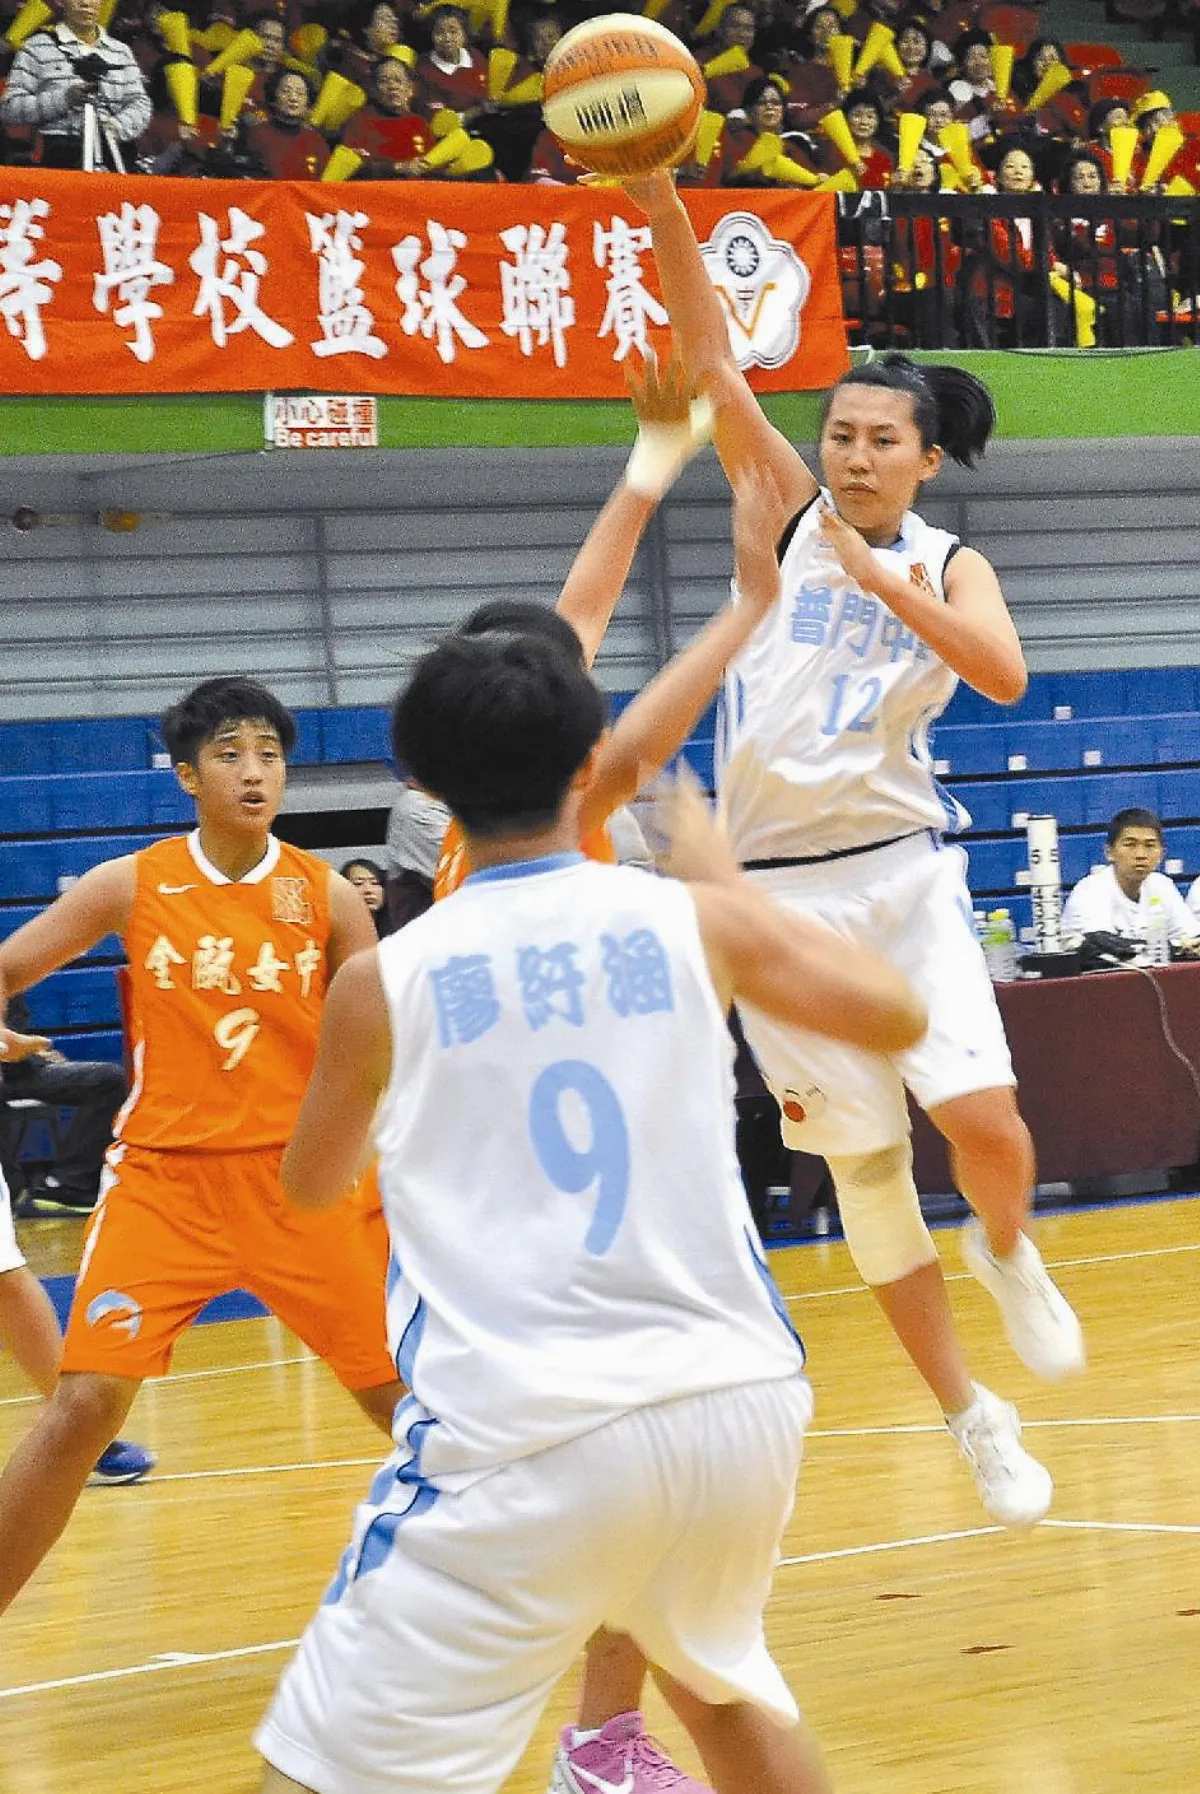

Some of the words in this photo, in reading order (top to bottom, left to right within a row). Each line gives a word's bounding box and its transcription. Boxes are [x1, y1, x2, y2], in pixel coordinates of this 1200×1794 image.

[274, 427, 302, 447] Be
[306, 427, 374, 447] careful
[790, 584, 931, 662] 普門中
[821, 674, 882, 735] 12
[213, 1006, 261, 1072] 9
[529, 1059, 632, 1257] 9
